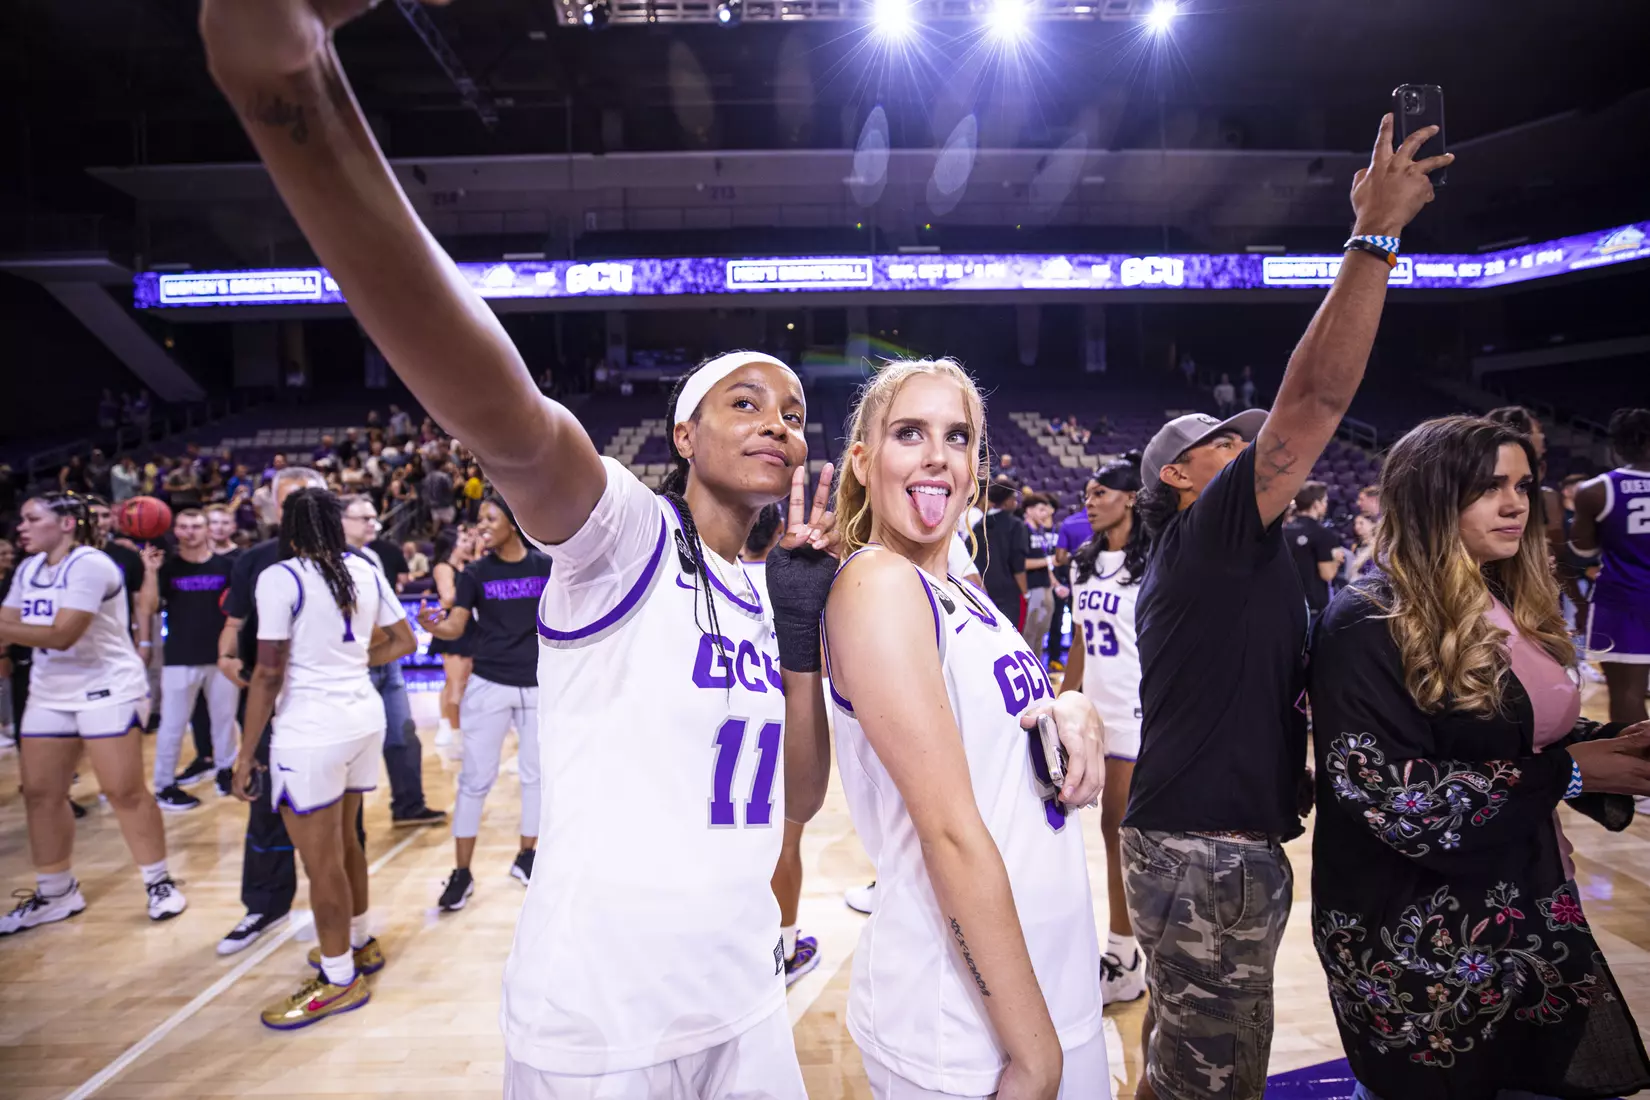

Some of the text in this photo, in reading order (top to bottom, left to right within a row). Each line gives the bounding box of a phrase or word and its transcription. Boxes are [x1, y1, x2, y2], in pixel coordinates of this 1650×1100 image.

[229, 277, 316, 294] BASKETBALL
[566, 262, 633, 294] GCU
[778, 264, 867, 280] BASKETBALL
[1121, 257, 1184, 286] GCU
[1079, 590, 1121, 615] GCU
[1083, 619, 1120, 657] 23
[707, 715, 784, 829] 11
